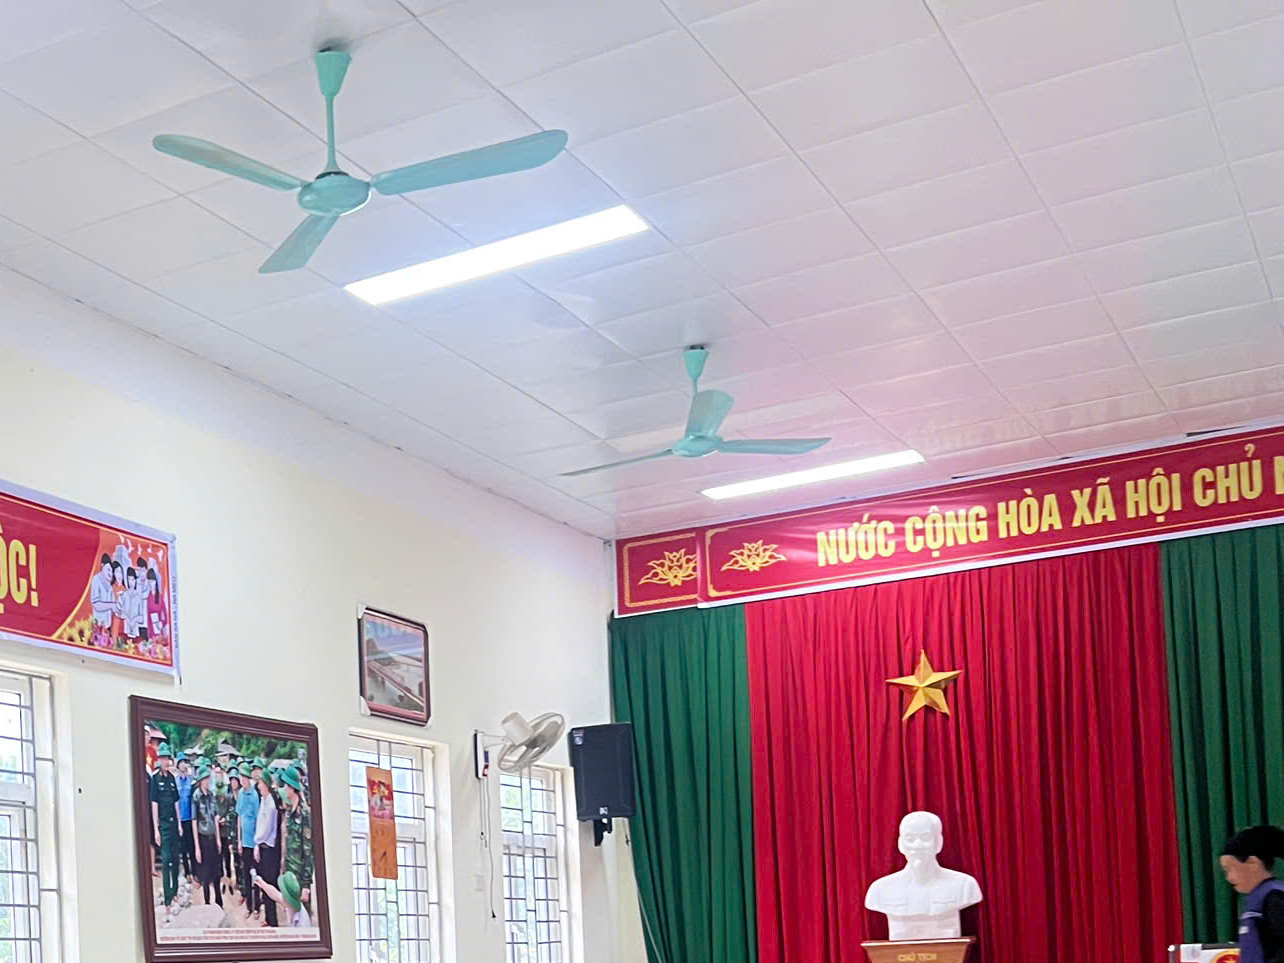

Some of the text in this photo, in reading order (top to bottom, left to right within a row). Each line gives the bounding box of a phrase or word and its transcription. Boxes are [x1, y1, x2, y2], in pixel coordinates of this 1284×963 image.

[816, 512, 897, 568] NƯỚC
[904, 503, 988, 555] CỘNG
[997, 487, 1062, 539] HÒA
[1071, 476, 1117, 527] XÃ
[1125, 466, 1182, 520] HỘI
[1194, 443, 1263, 508] CHỦ
